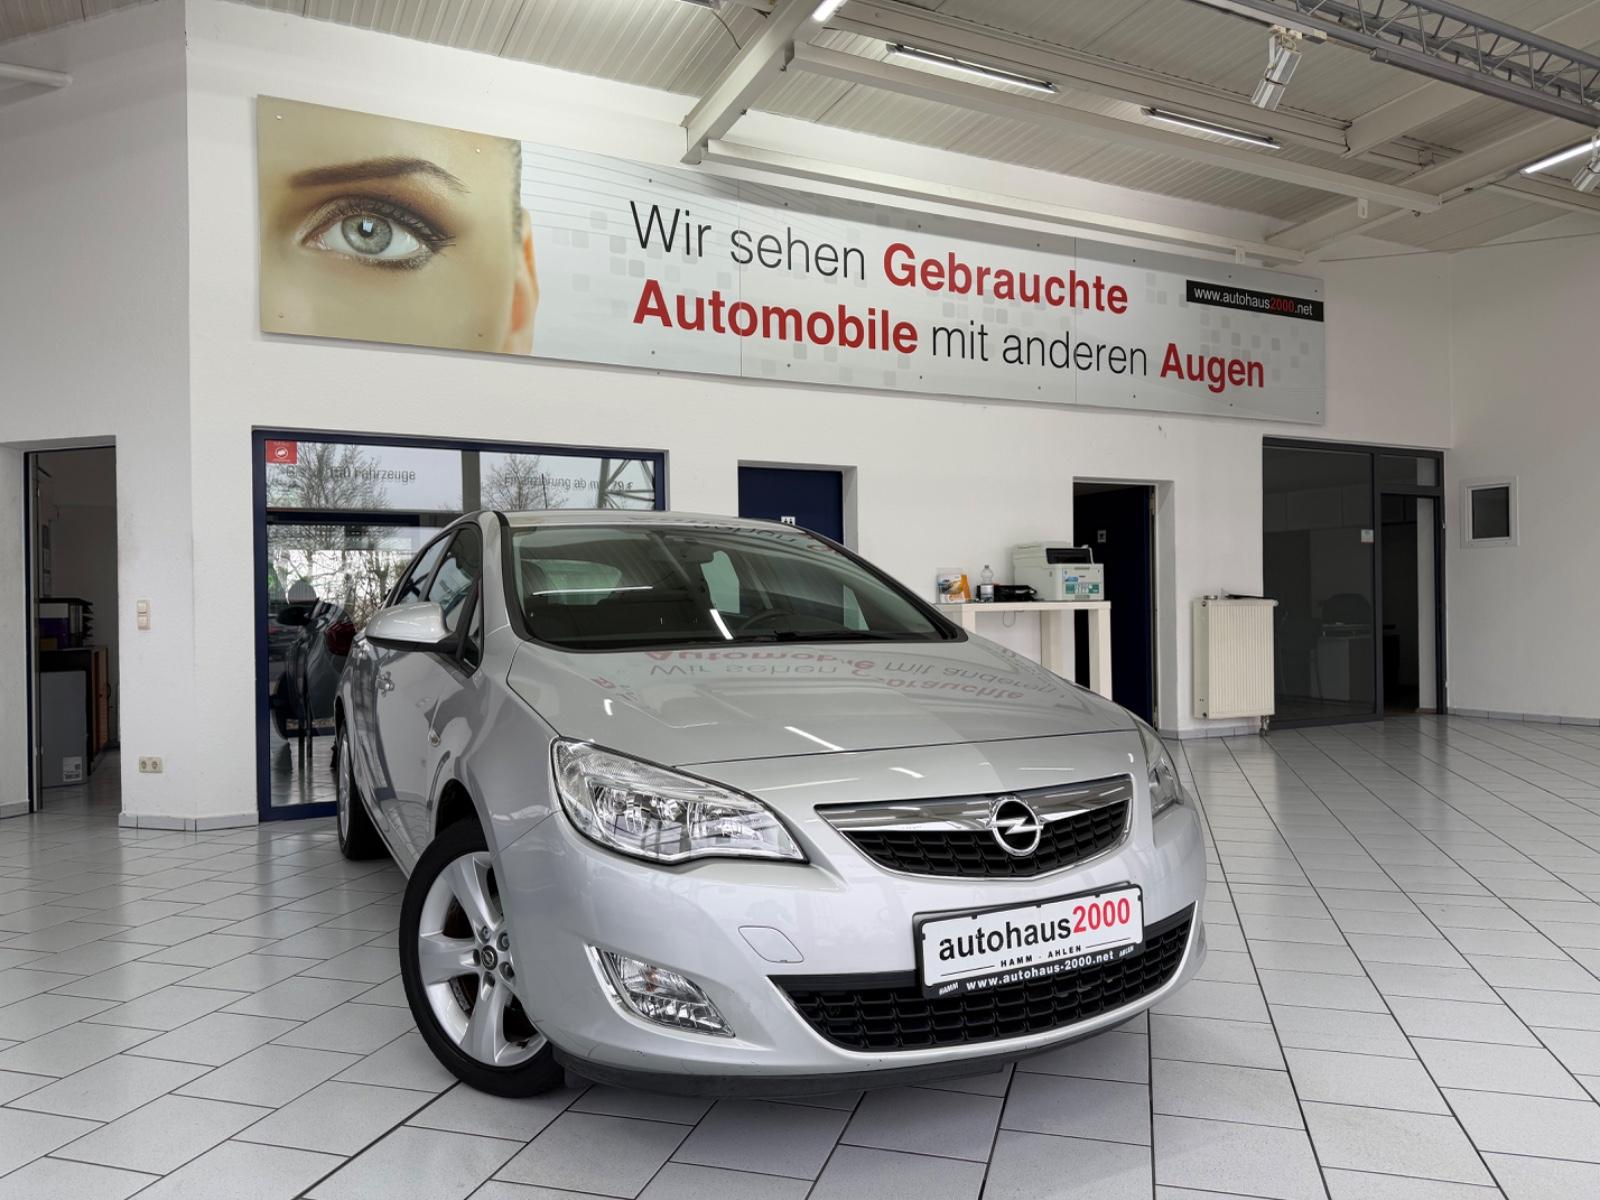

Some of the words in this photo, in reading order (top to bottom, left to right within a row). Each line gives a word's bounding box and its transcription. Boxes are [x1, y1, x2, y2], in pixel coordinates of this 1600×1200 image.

[630, 200, 712, 257] Wir
[730, 227, 865, 281] sehen
[884, 242, 1128, 314] Gebrauchte
[1193, 287, 1313, 316] www.autohaus2000.net
[633, 278, 918, 354] Automobile
[932, 320, 988, 362] mit
[1003, 331, 1147, 376] anderen
[1160, 343, 1265, 394] Augen
[938, 897, 1131, 962] autohaus2000
[966, 950, 1114, 991] www.autohaus-2000.net
[1000, 955, 1033, 968] HAMM
[1047, 945, 1082, 958] AHLEN
